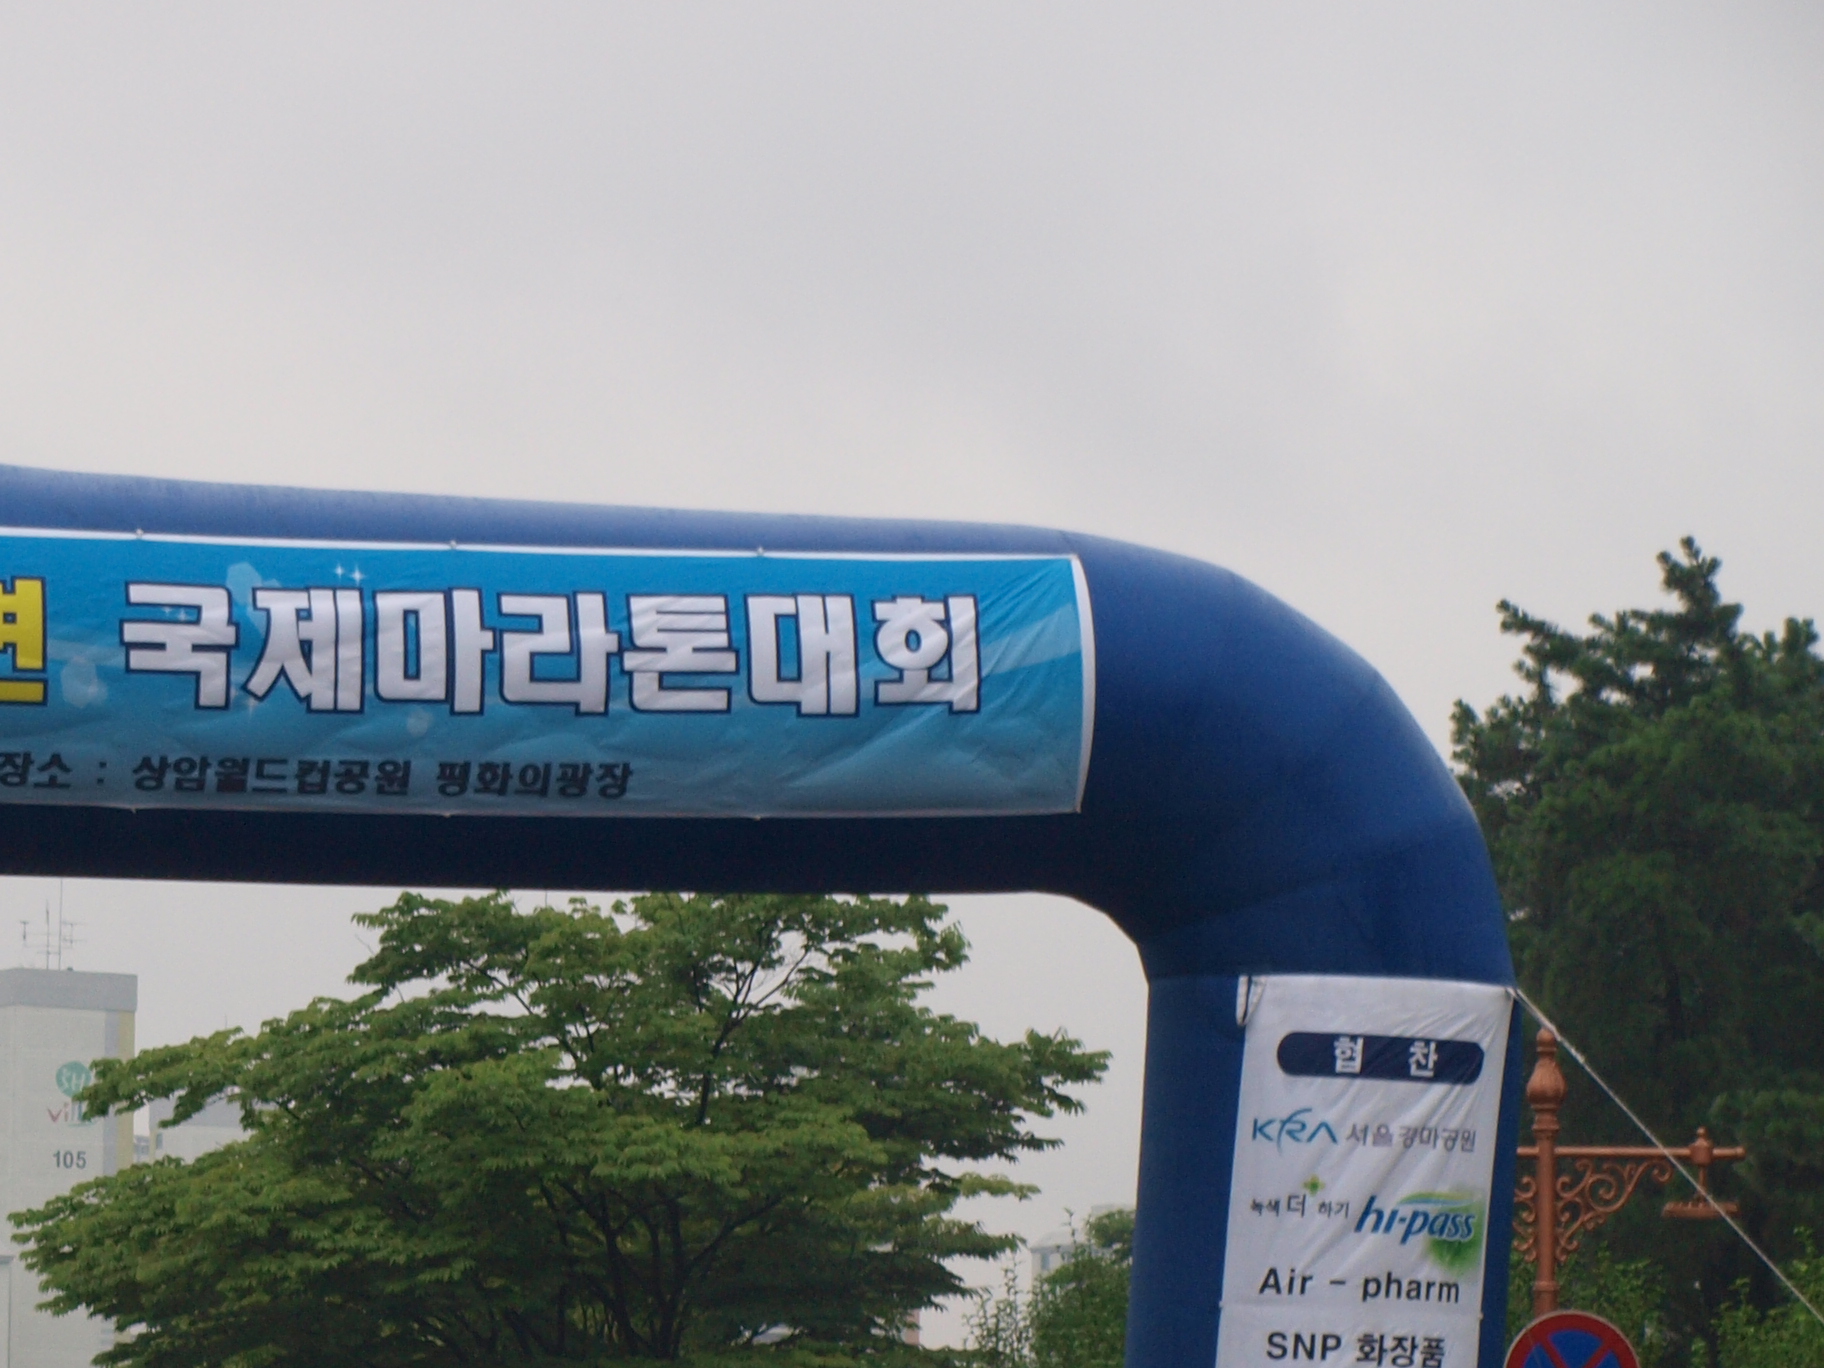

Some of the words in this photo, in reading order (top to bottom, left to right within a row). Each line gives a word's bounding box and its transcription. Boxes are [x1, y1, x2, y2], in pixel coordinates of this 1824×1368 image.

[119, 581, 981, 717] 국제마라톤대회
[131, 754, 412, 796] 상암월드컵공원
[436, 760, 634, 800] 평화의광장
[1252, 1107, 1338, 1149] KRA
[52, 1150, 87, 1169] 105
[1354, 1195, 1475, 1245] hi-pass
[1259, 1267, 1314, 1297] Air
[1361, 1272, 1460, 1303] pharm
[1266, 1332, 1343, 1361] SNP
[1356, 1333, 1445, 1368] 화장품
